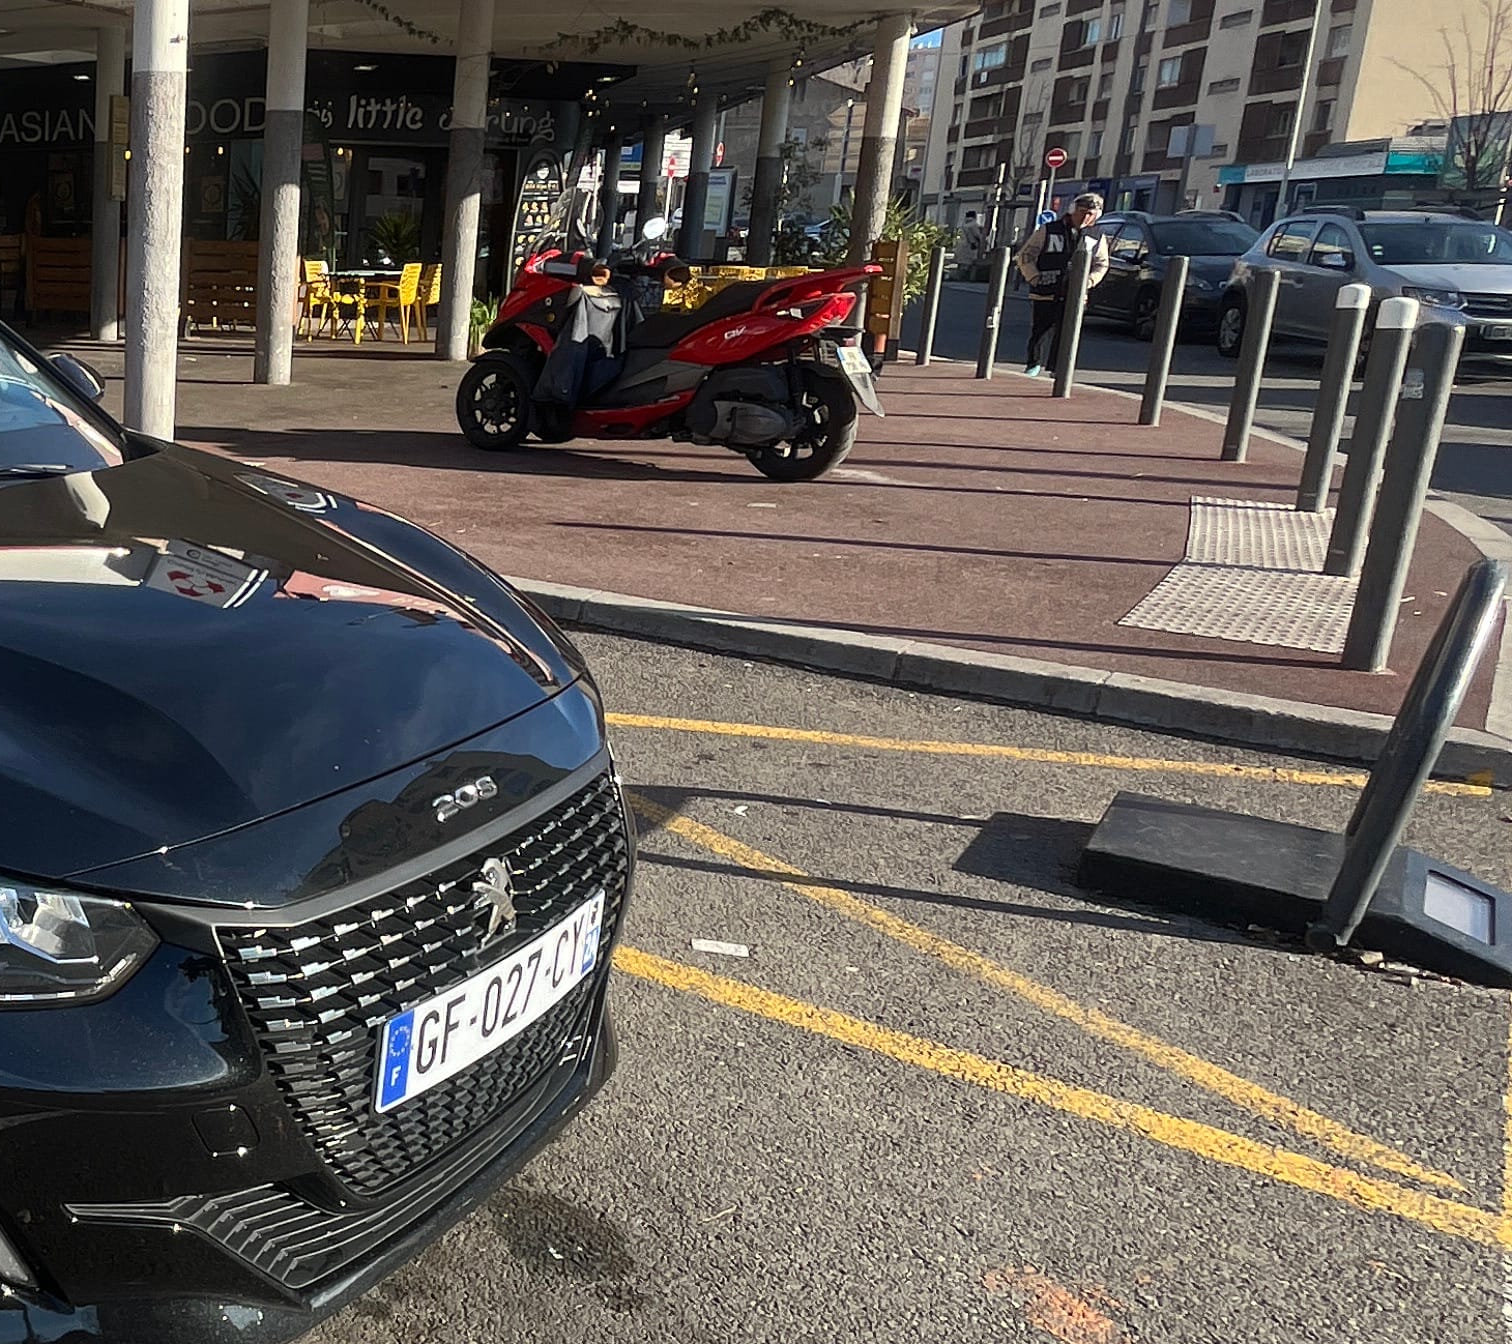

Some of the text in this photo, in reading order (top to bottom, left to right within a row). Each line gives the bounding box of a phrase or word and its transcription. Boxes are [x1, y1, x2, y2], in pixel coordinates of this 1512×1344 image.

[185, 98, 265, 136] OOD
[346, 95, 424, 130] little
[1048, 234, 1065, 253] N
[416, 913, 585, 1076] GF-027-CY
